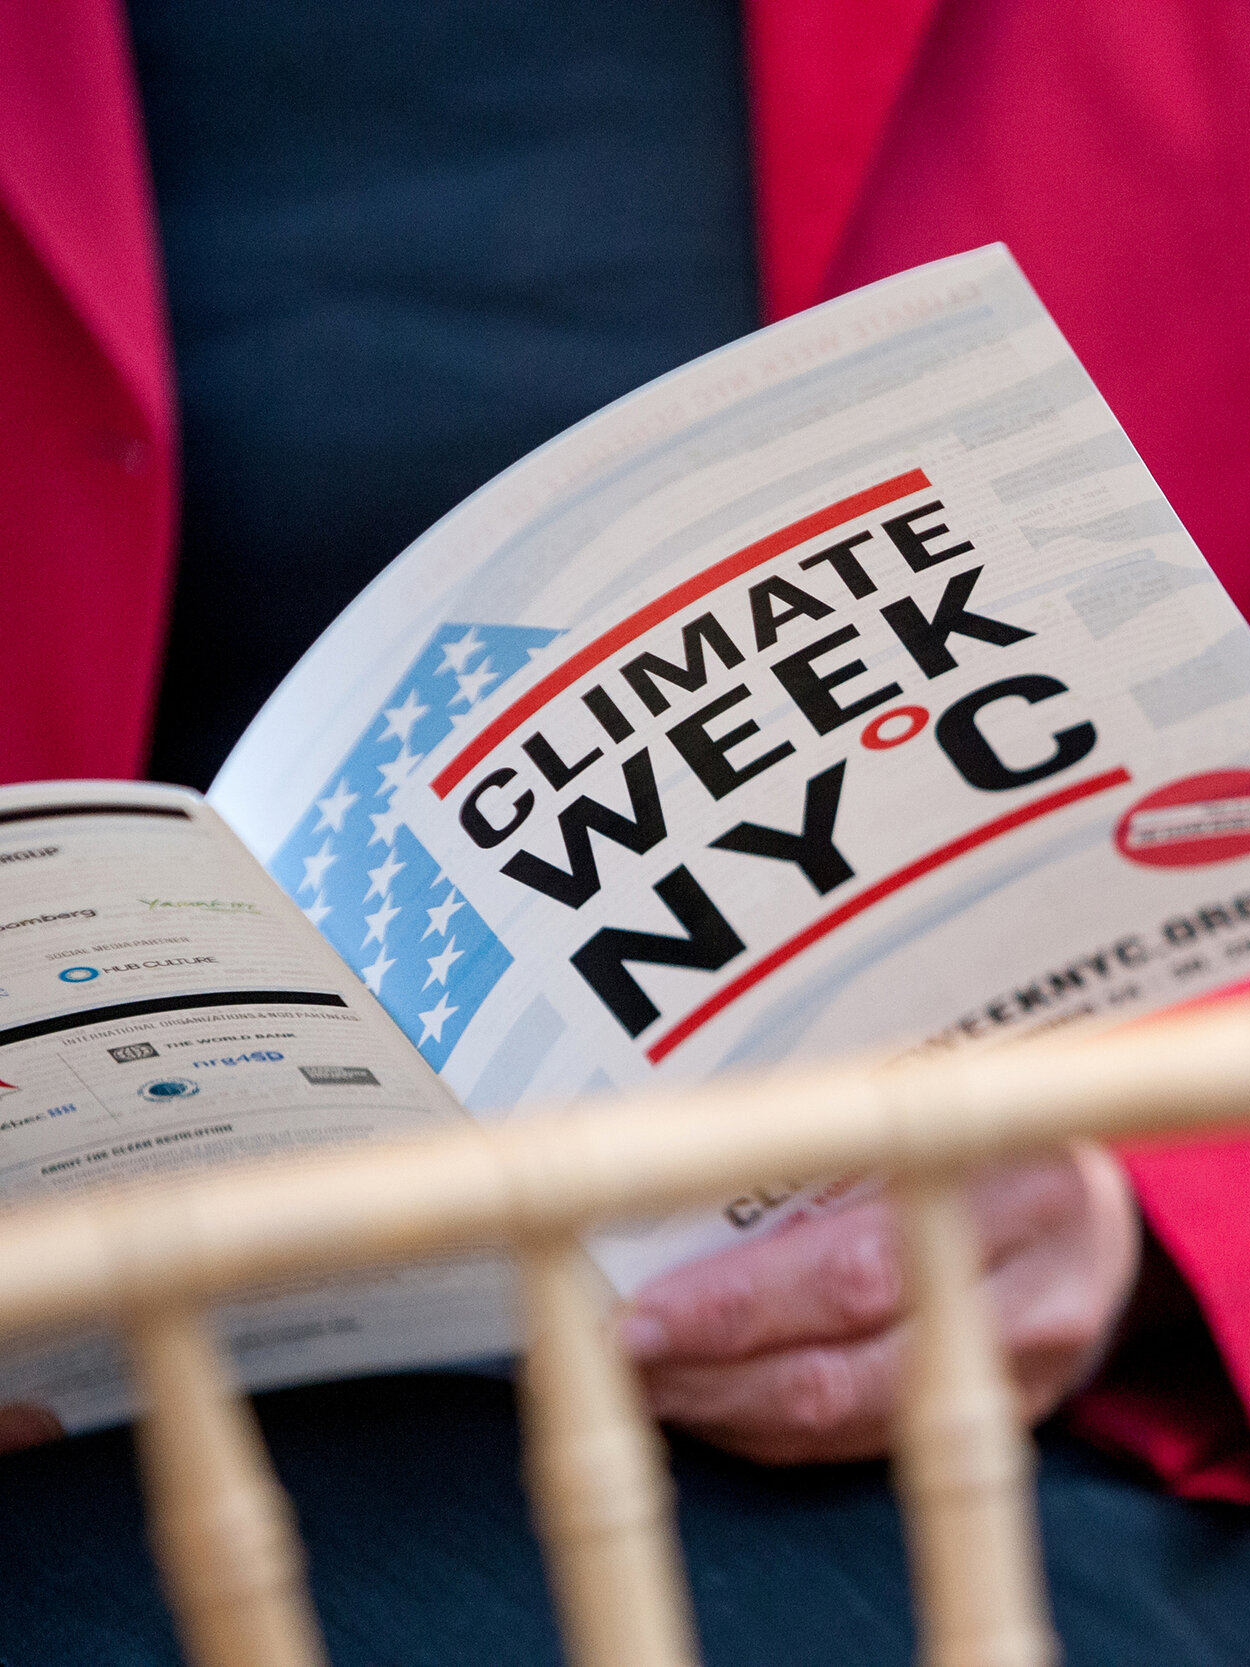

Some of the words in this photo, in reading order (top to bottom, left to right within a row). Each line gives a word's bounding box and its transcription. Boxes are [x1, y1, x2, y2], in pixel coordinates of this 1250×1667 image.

[458, 499, 976, 850] CLIMATE
[499, 563, 1038, 911] WEEK
[101, 961, 141, 974] HUB
[142, 956, 219, 969] CULTURE
[164, 1040, 193, 1050] THE
[199, 1034, 252, 1044] WORLD
[254, 1031, 297, 1041] BANK
